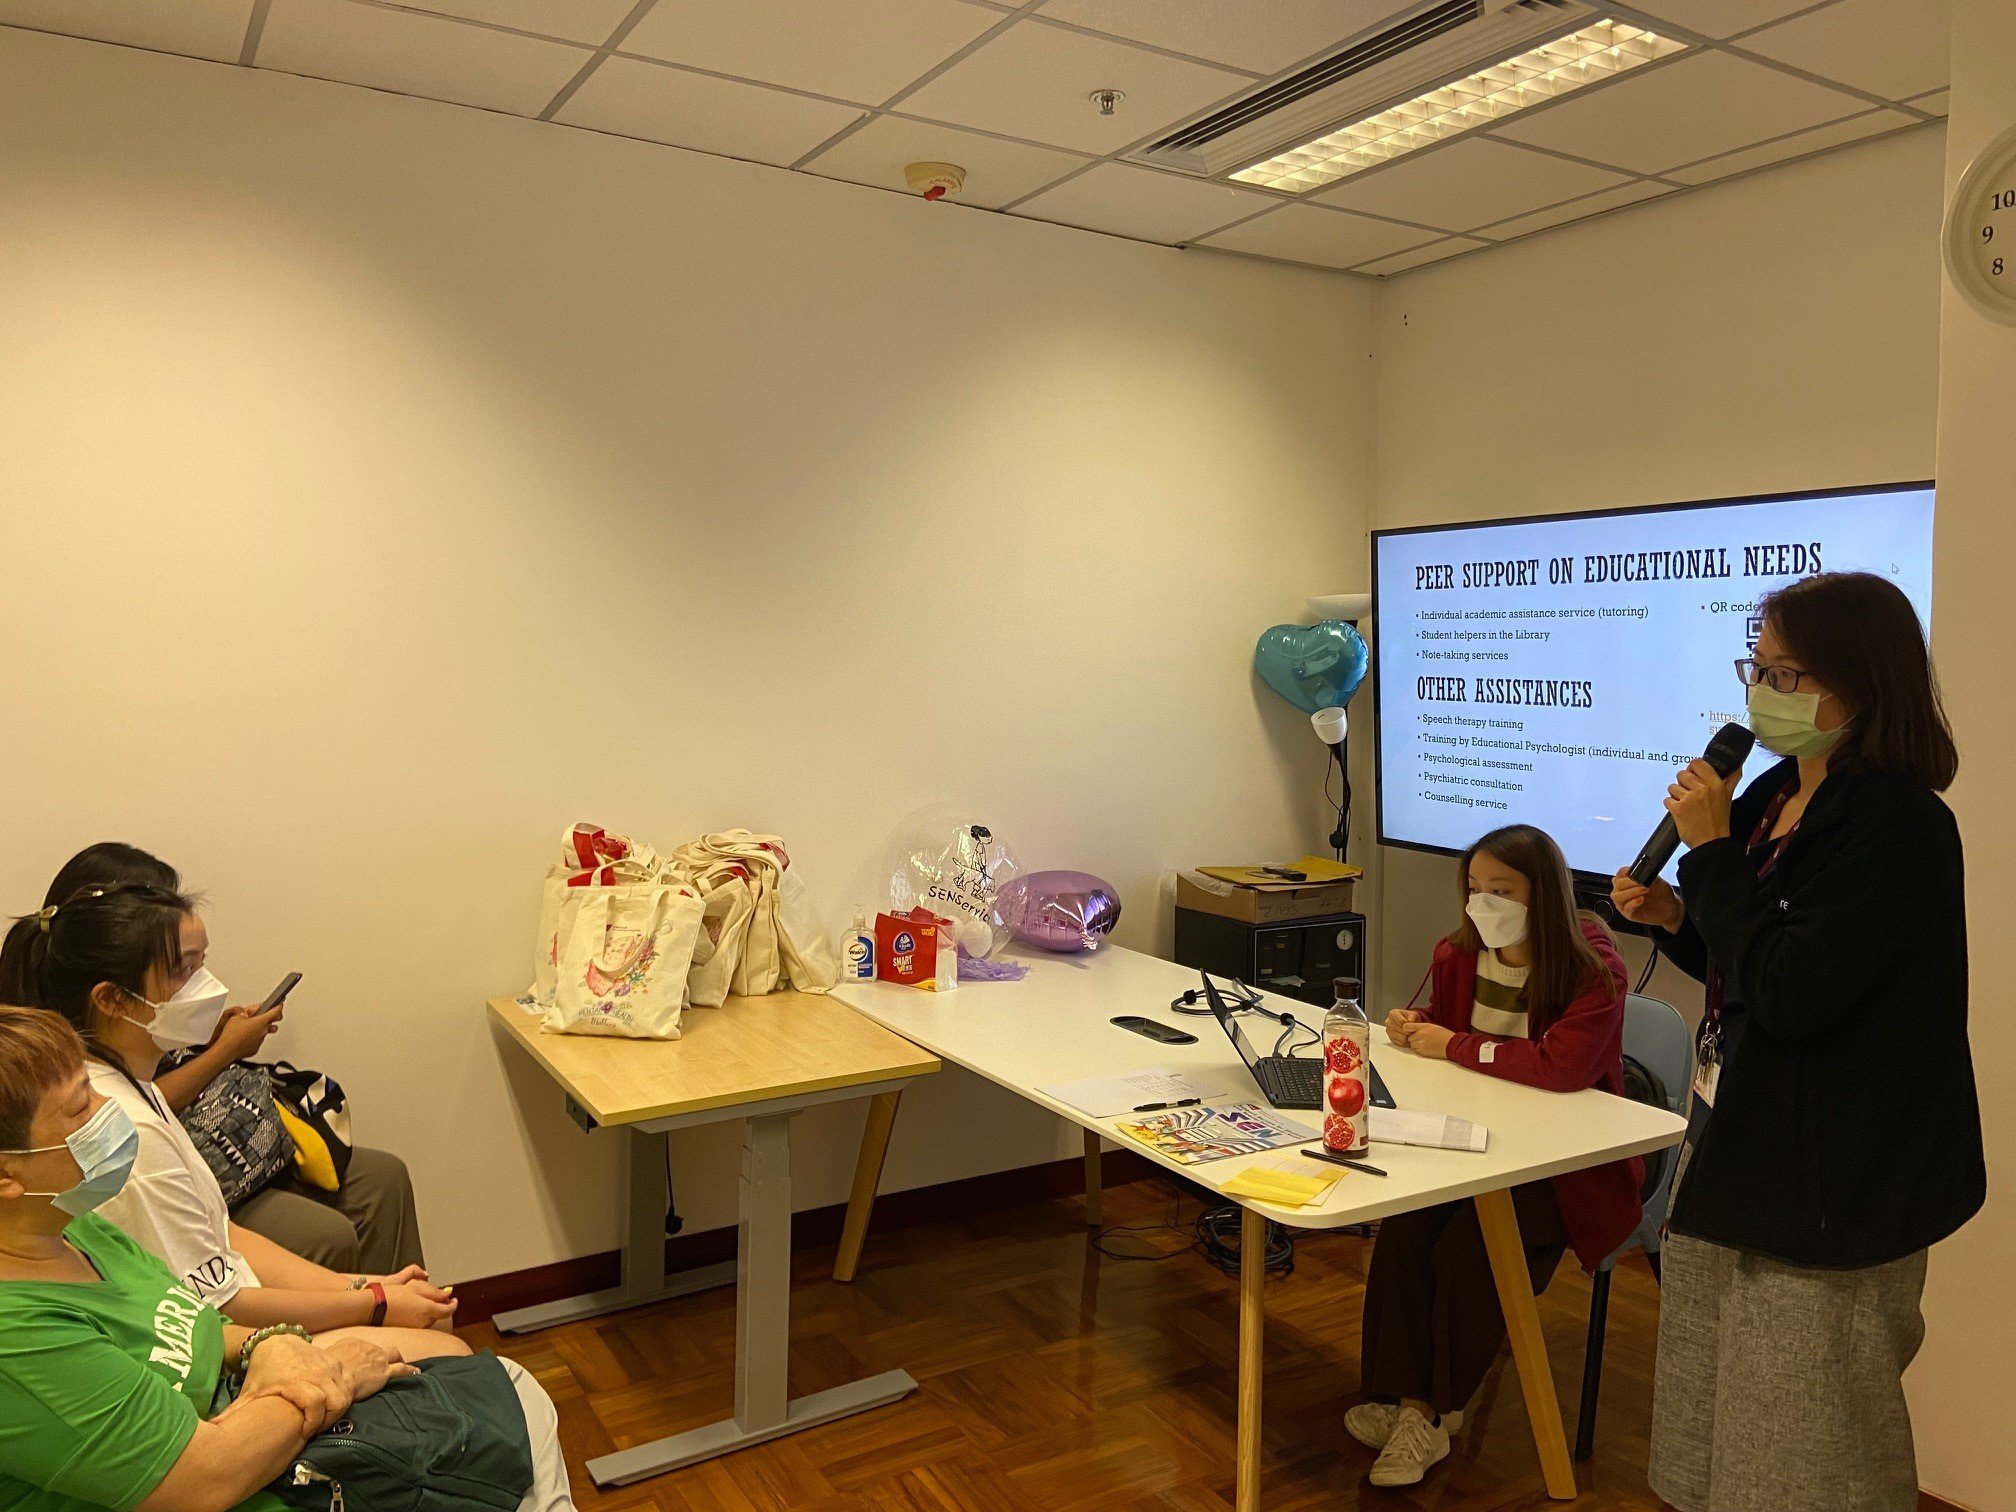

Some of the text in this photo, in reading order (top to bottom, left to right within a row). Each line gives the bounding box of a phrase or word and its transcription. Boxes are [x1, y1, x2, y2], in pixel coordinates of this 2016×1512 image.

[1991, 189, 2015, 211] 10
[1982, 226, 1994, 245] 9
[1992, 257, 2004, 276] 8
[1415, 542, 1822, 590] PEER SUPPORT ON EDUCATIONAL NEEDS
[1421, 605, 1649, 620] Individual academic assistance service (tutoring)
[1710, 601, 1728, 613] QR
[1421, 629, 1550, 642] Student helpers in the Library
[1421, 650, 1509, 662] Note-taking services
[1417, 675, 1593, 708] OTHER ASSISTANCES
[1422, 713, 1524, 731] Speech therapy training
[1423, 733, 1457, 746] Training
[1458, 736, 1469, 747] by
[1471, 737, 1523, 750] Educational
[1525, 741, 1586, 757] Psychologist
[1588, 746, 1645, 760] (individual
[1647, 751, 1668, 762] and
[1423, 752, 1533, 772] Psychological assessment
[1424, 771, 1524, 791] Psychiatric consultation
[1424, 791, 1508, 810] Counselling service
[892, 954, 914, 967] SMART
